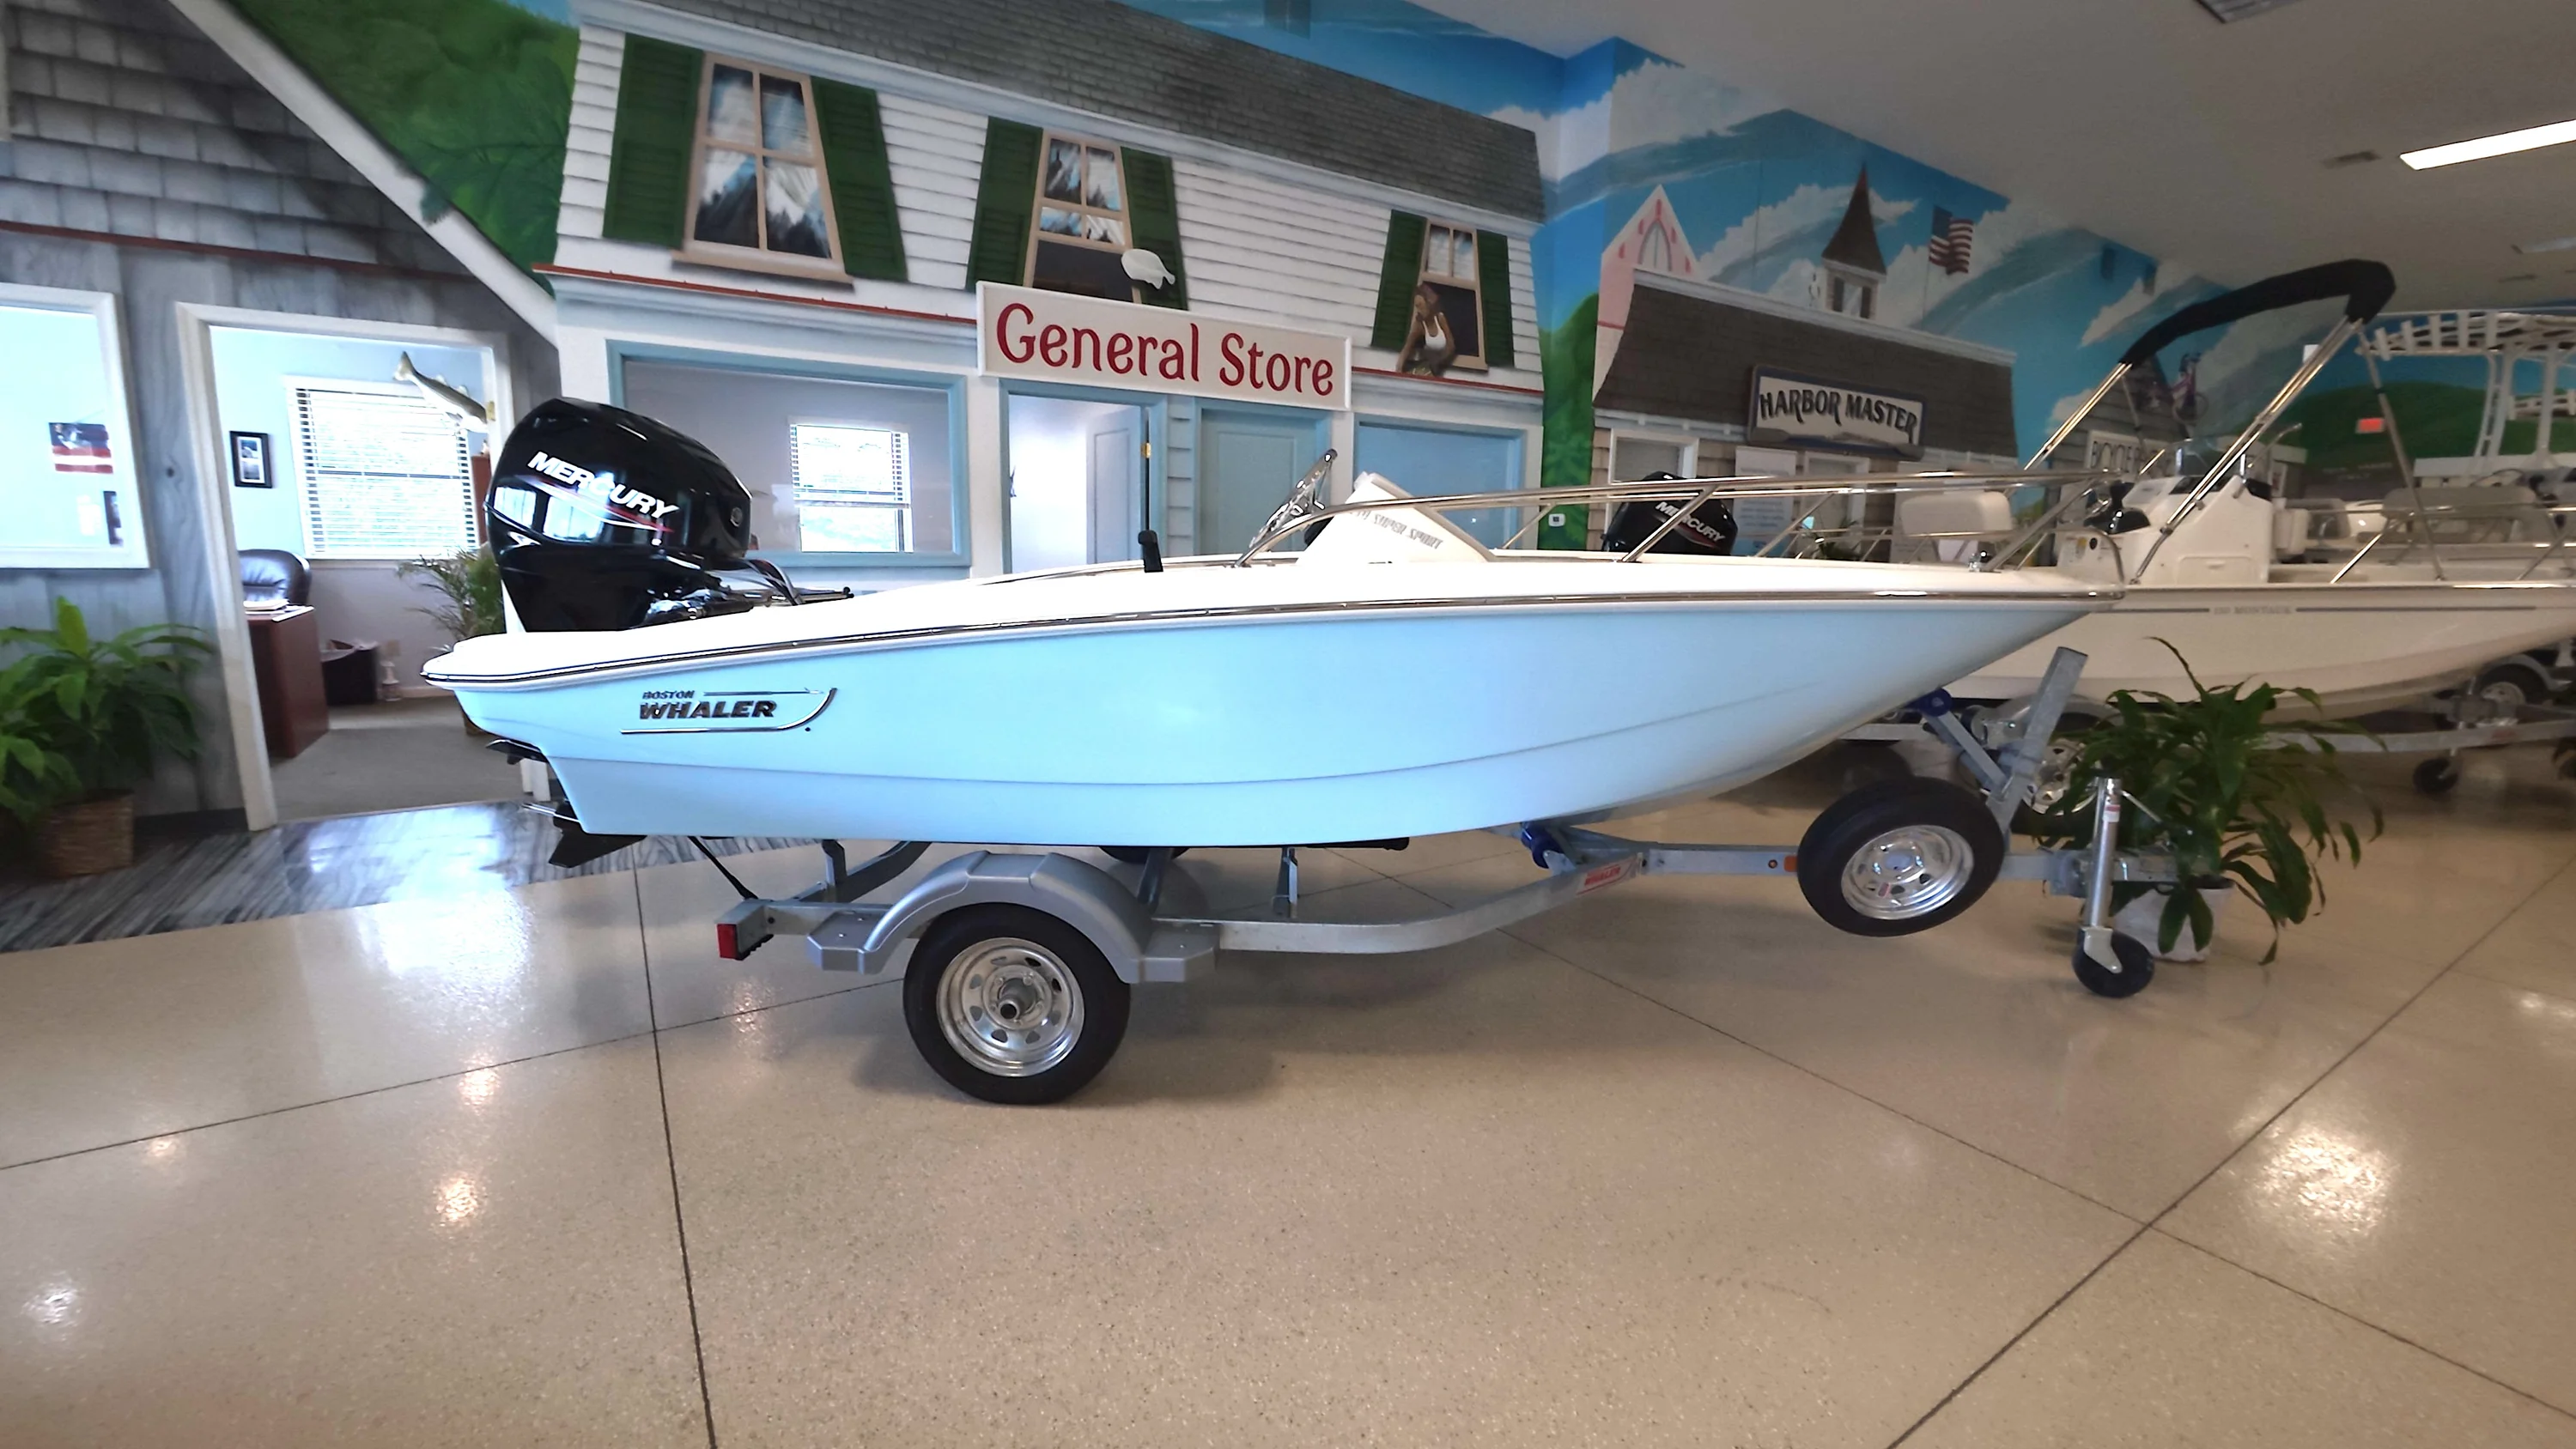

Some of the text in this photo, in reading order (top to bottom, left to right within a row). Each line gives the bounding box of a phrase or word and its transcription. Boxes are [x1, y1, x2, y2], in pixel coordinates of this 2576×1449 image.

[996, 303, 1334, 396] General Store
[1759, 389, 1917, 446] HARBOR MASTER
[527, 451, 680, 519] MERCURY
[1408, 528, 1443, 549] SPORT
[640, 700, 777, 719] WHALER
[642, 689, 695, 700] BOSTON
